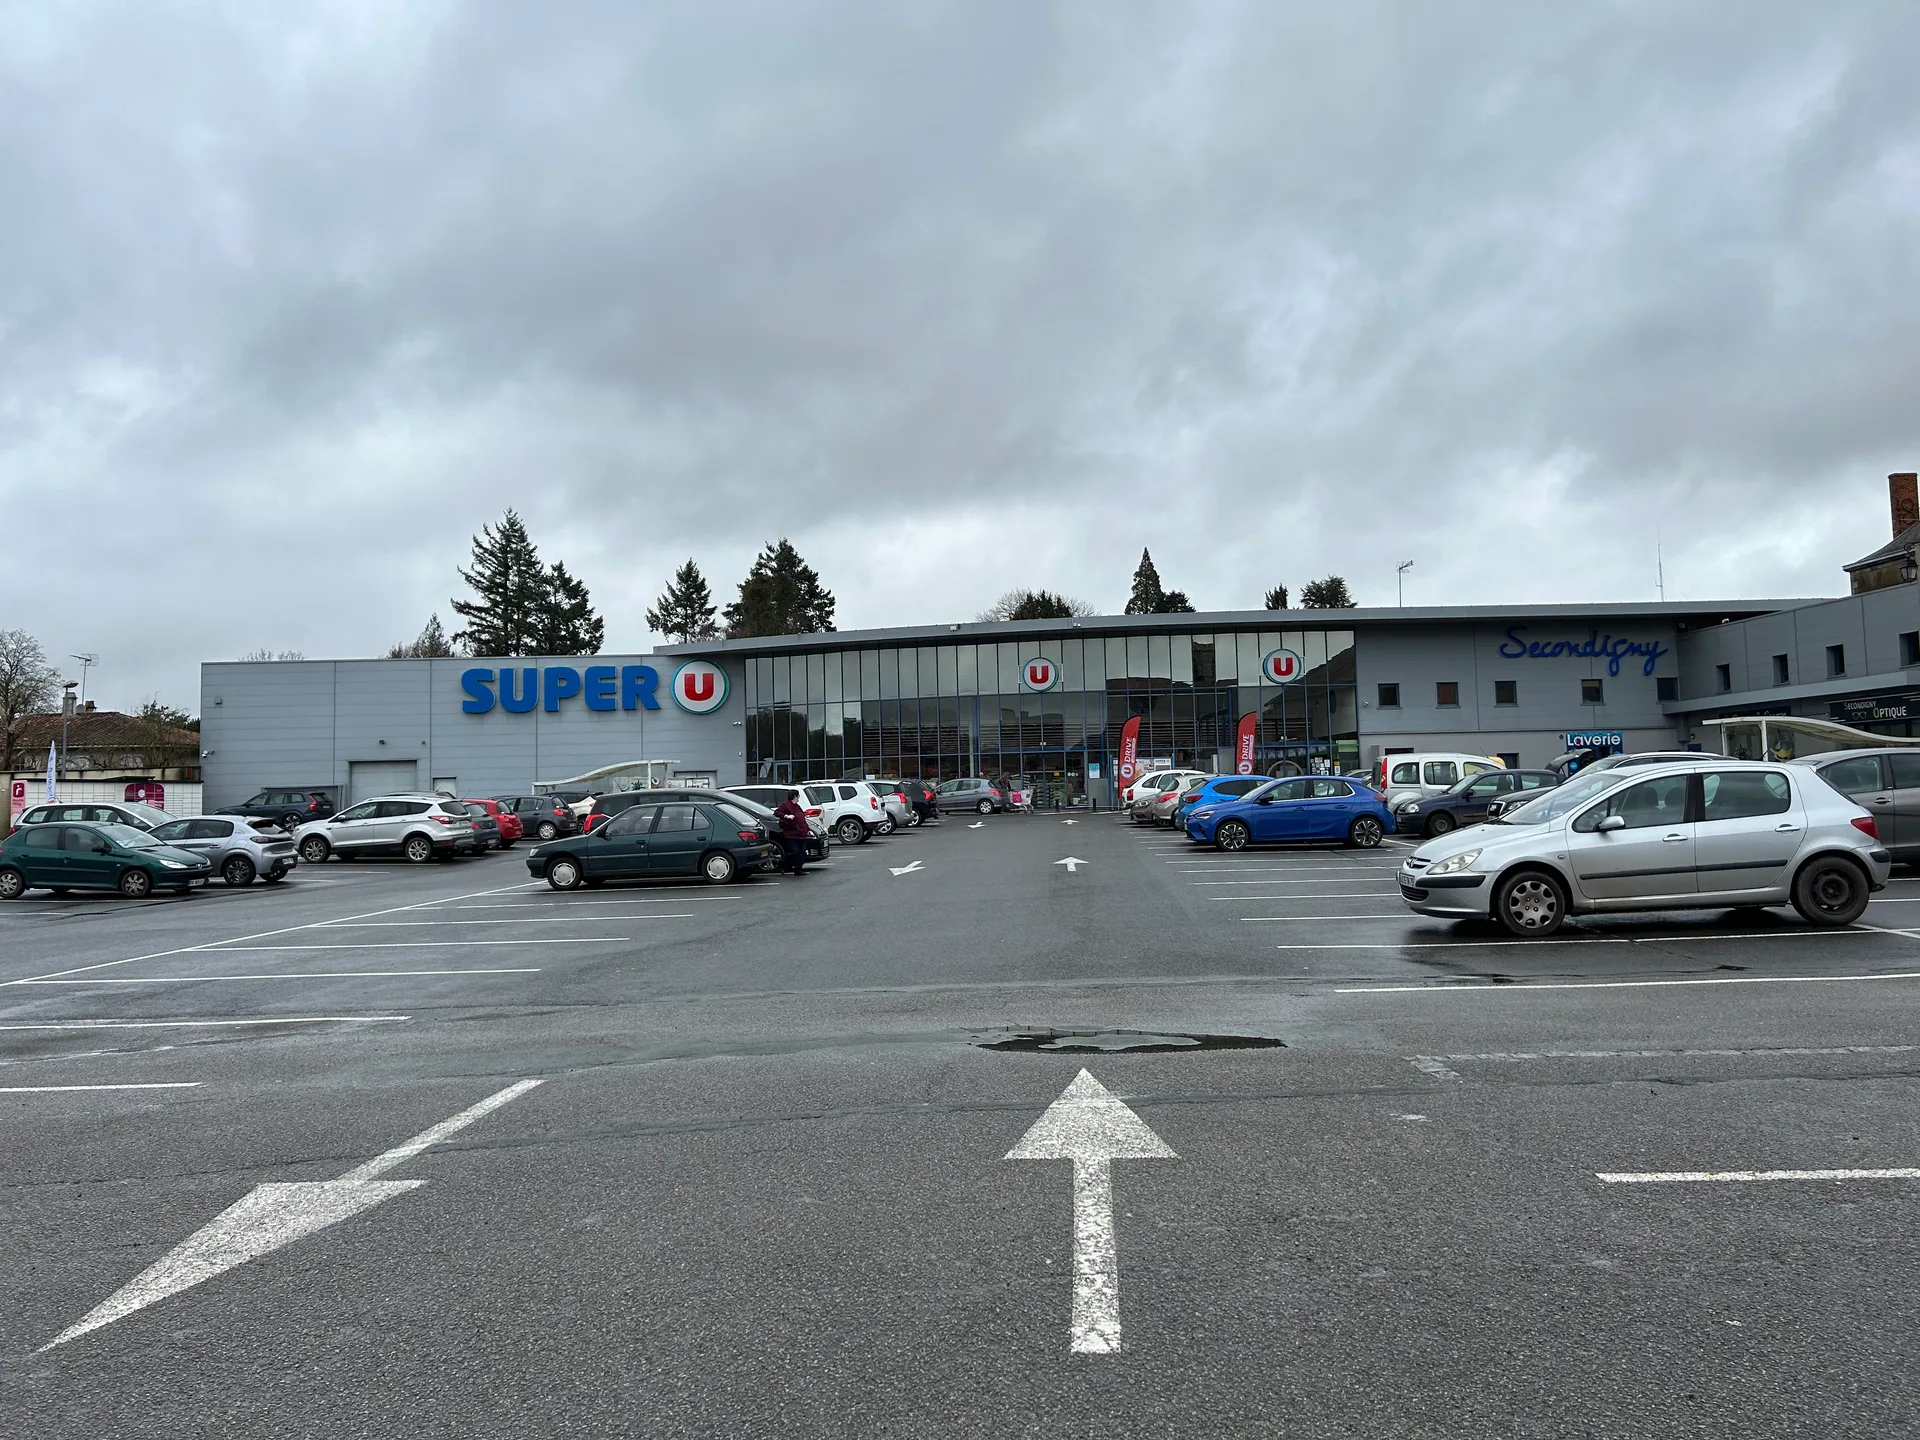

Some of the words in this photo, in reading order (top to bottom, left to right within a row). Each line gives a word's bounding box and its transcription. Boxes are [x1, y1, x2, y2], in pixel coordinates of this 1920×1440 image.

[1499, 625, 1668, 677] Secondigny
[1029, 665, 1049, 684] U
[1273, 657, 1294, 677] U
[461, 665, 661, 714] SUPER
[684, 673, 714, 702] U
[1843, 700, 1877, 711] SECONDIGNY
[1873, 705, 1907, 719] OPTIQUE
[1242, 733, 1250, 760] DRIVE
[1567, 732, 1621, 746] Laverie
[1124, 736, 1133, 763] DRIVE
